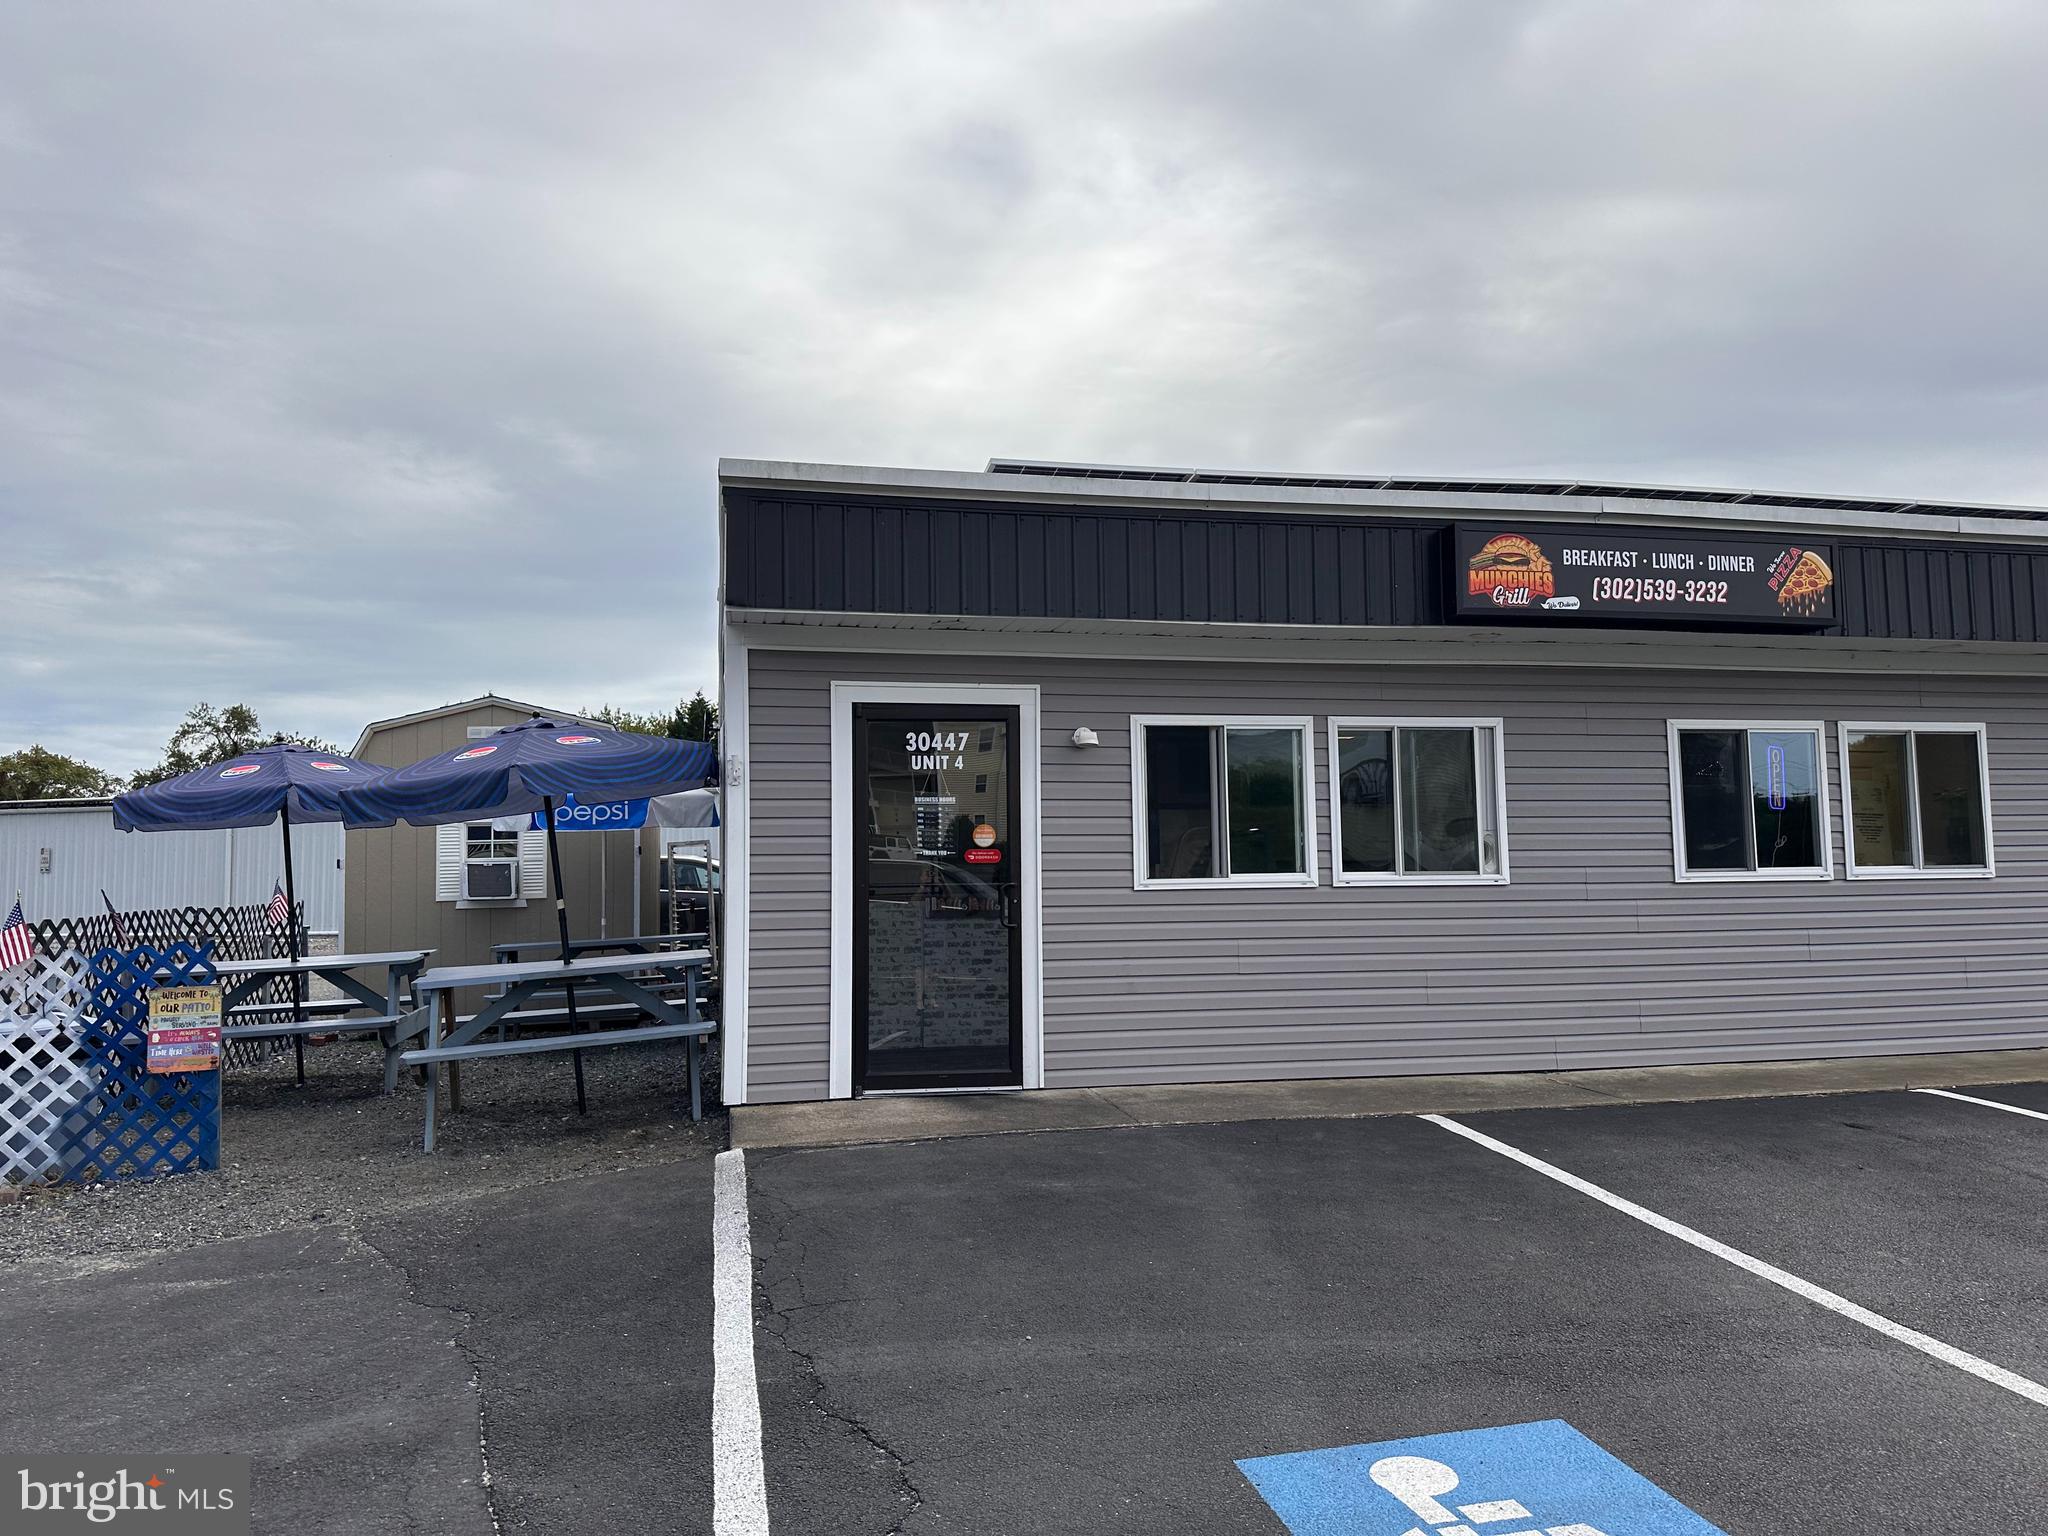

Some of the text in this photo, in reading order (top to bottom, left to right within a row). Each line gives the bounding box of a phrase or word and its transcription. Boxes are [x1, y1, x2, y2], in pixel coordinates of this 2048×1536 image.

[1563, 549, 1755, 572] BREAKFAST LUNCH DINNER
[1768, 547, 1802, 591] PIZZA
[1469, 570, 1553, 595] MUNCHIES
[1592, 577, 1728, 603] (302)539-3232
[1493, 585, 1531, 605] Grill
[905, 732, 970, 752] 30447
[911, 755, 964, 770] UNIT 4
[1772, 750, 1781, 807] OPEN
[554, 800, 629, 826] pepsi
[162, 990, 209, 1000] WELCOME TO
[160, 1002, 211, 1013] OUR PATIO
